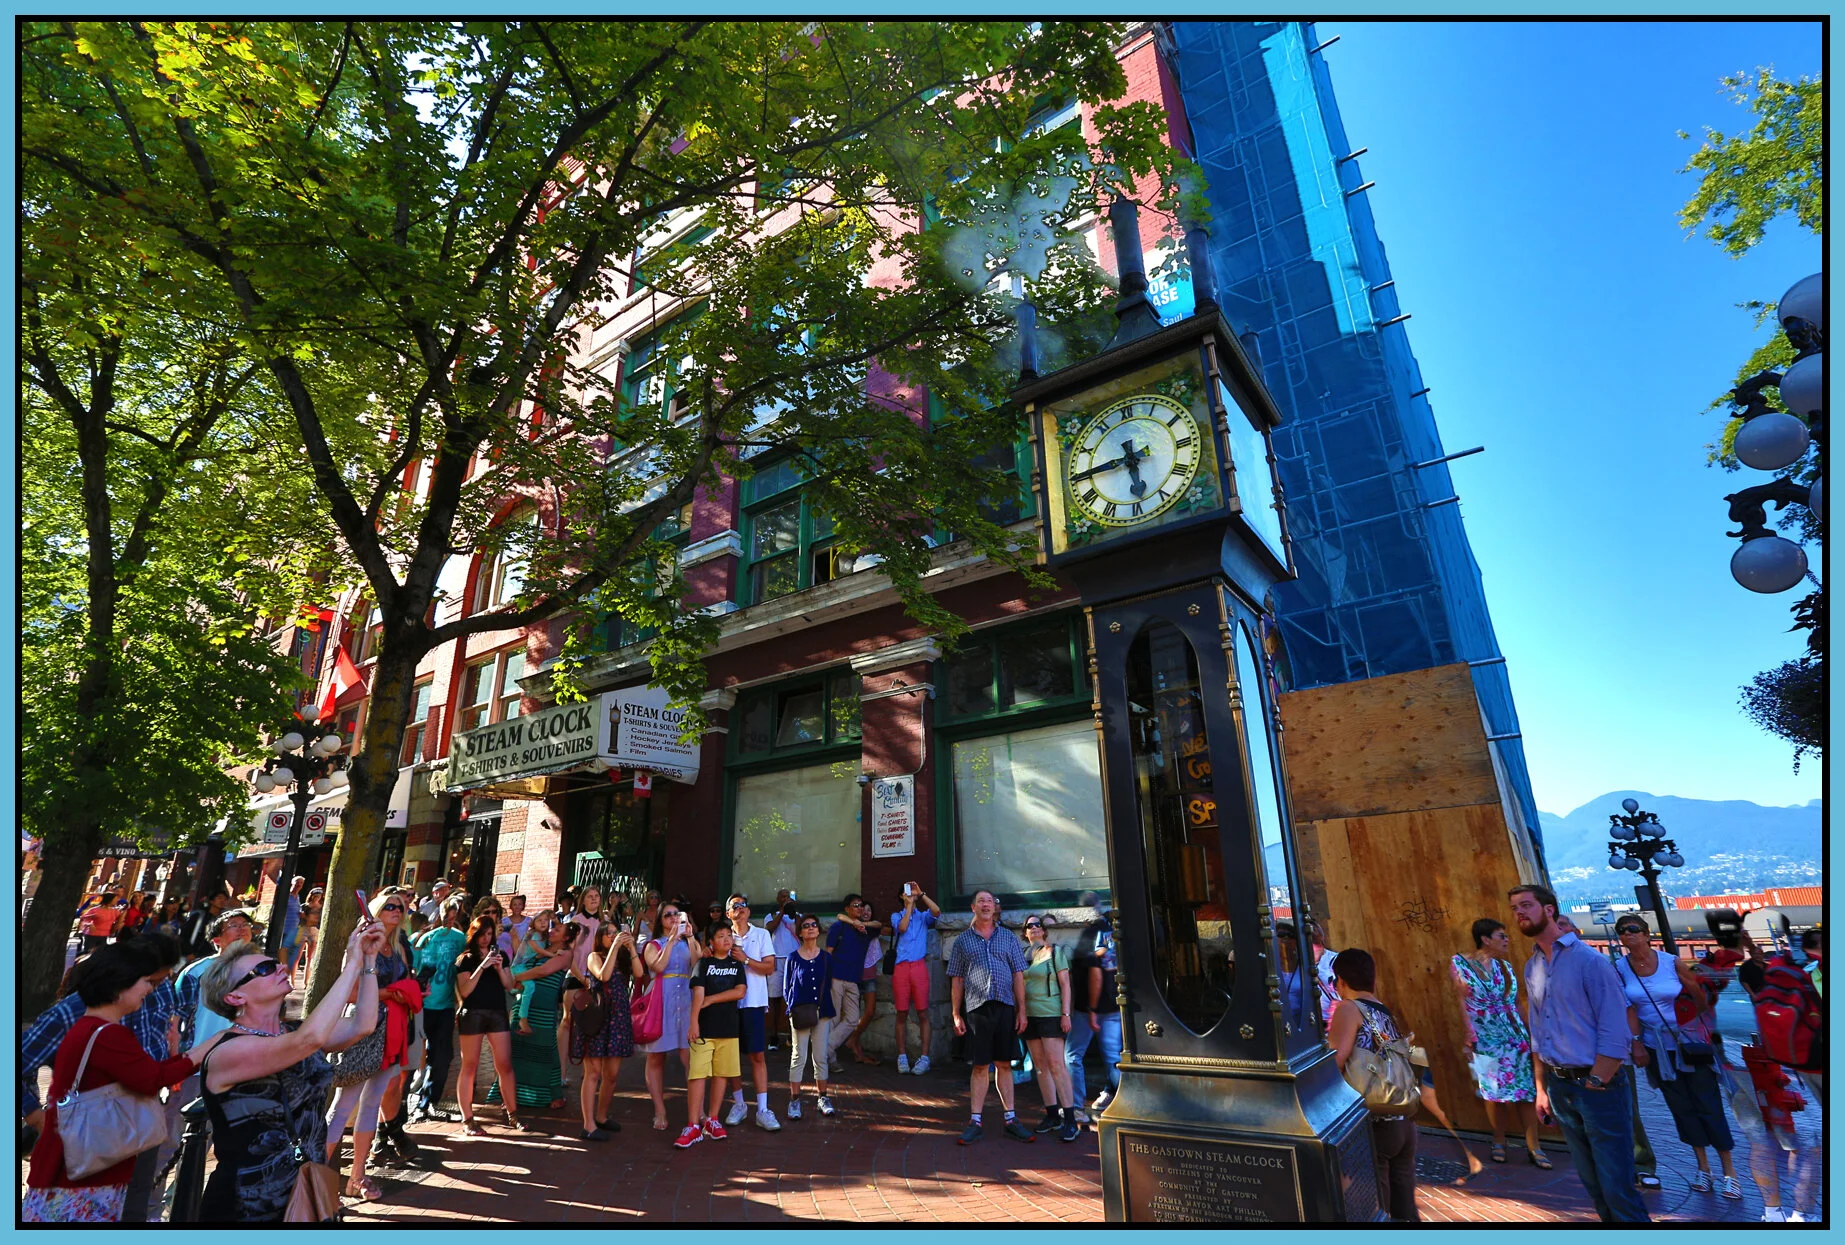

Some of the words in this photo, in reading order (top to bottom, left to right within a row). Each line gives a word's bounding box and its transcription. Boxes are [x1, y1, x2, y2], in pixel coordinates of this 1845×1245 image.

[1149, 280, 1170, 295] OR
[1152, 287, 1179, 307] ASE
[624, 703, 659, 720] STEAM
[624, 717, 652, 728] T-SHIRTS
[465, 723, 524, 757] STEAM
[528, 705, 593, 743] CLOCK
[631, 727, 668, 738] Canadian
[630, 735, 660, 745] Hockey
[461, 754, 507, 777] T-SHIRTS
[509, 752, 519, 767] &
[521, 735, 593, 765] SOUVENIRS
[630, 741, 663, 751] Smoked
[664, 747, 693, 756] Salmon
[1129, 1142, 1150, 1155] THE
[1152, 1145, 1203, 1161] GASTOWN
[1206, 1152, 1242, 1165] STEAM
[1244, 1155, 1285, 1169] CLOCK
[1180, 1162, 1214, 1172] DEDICATED
[1151, 1165, 1164, 1174] THE
[1167, 1167, 1201, 1178] CITIZENS
[1204, 1172, 1213, 1180] OF
[1216, 1173, 1262, 1185] VANCOUVER
[1159, 1181, 1200, 1193] COMMUNITY
[1154, 1195, 1182, 1205] FORMER
[1186, 1200, 1212, 1210] MAYOR
